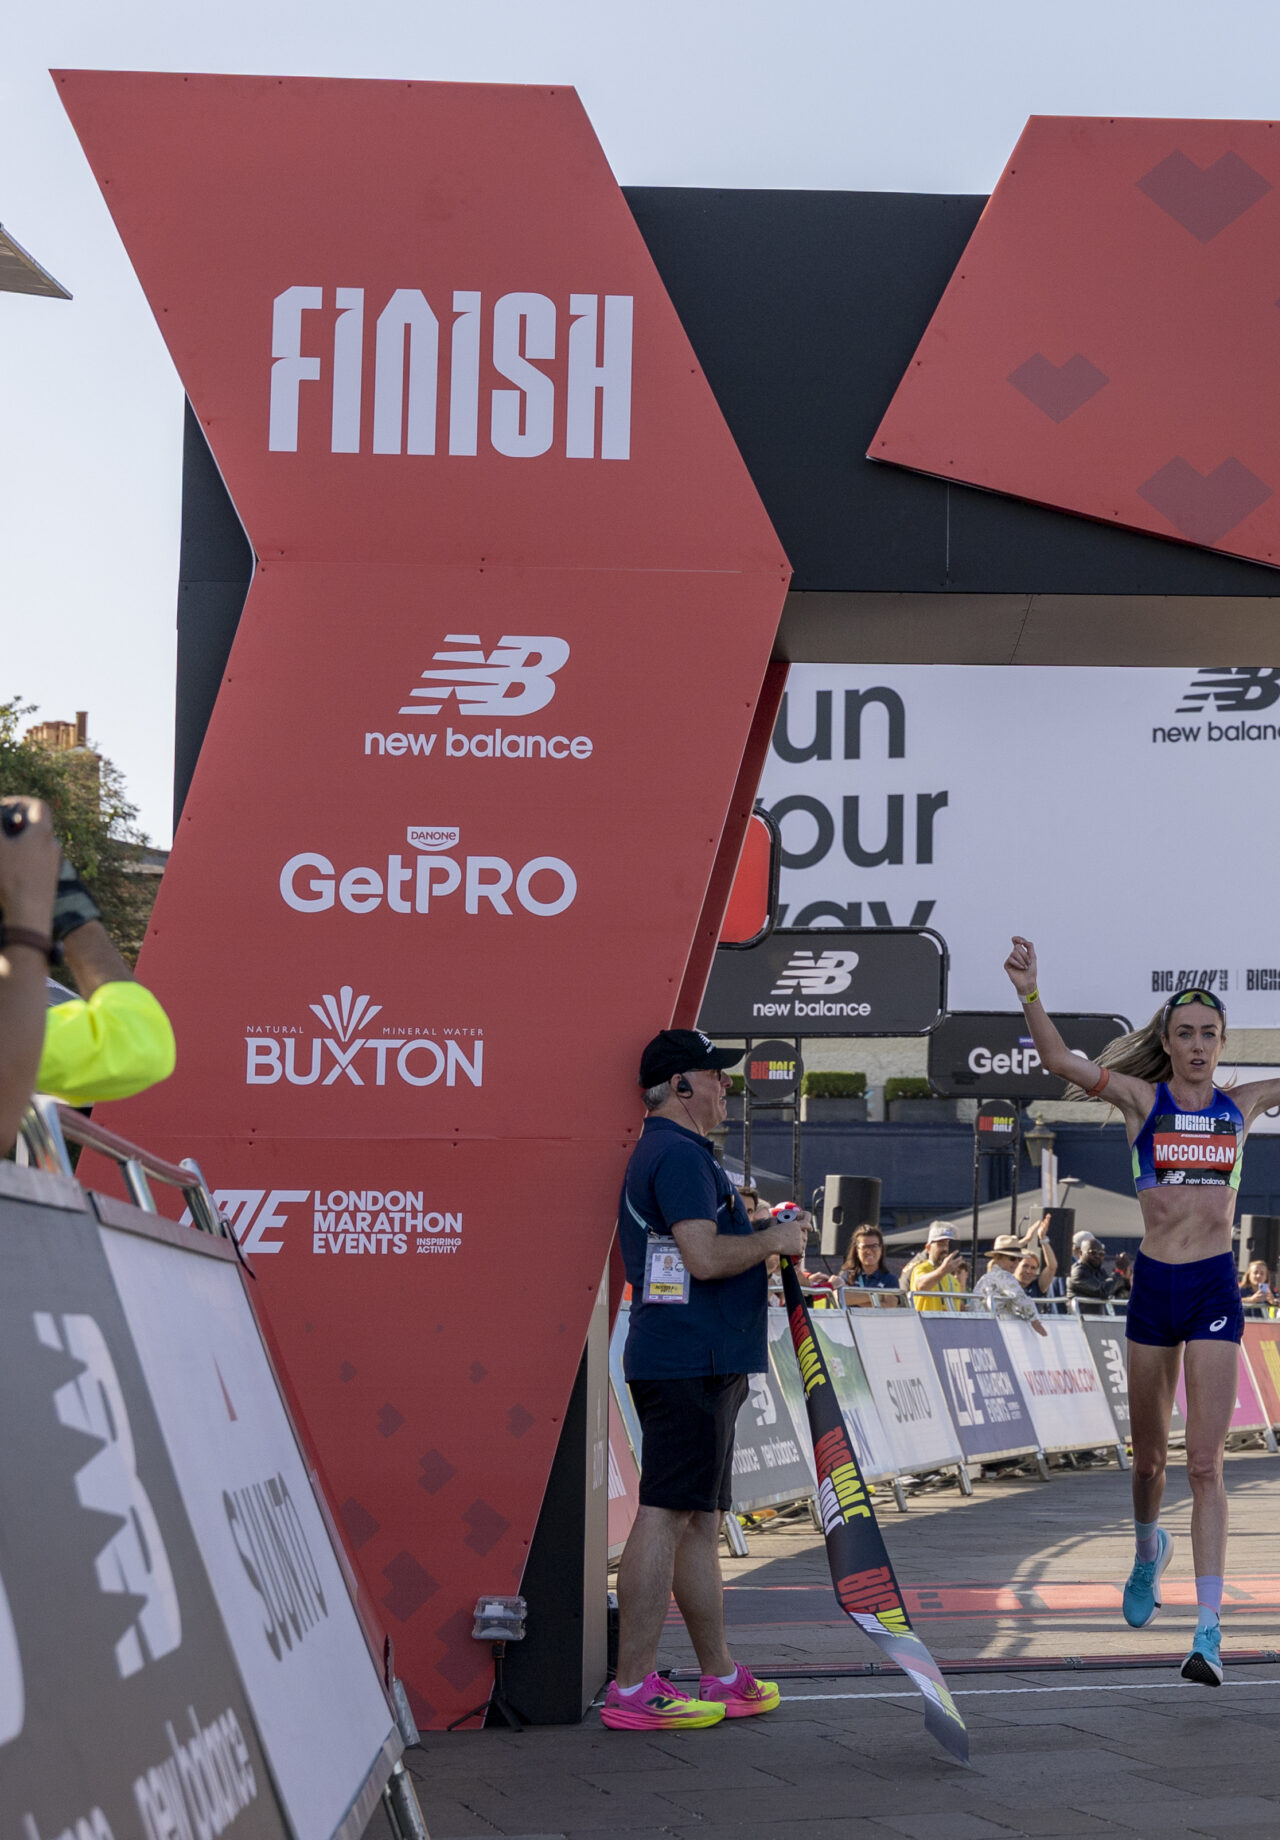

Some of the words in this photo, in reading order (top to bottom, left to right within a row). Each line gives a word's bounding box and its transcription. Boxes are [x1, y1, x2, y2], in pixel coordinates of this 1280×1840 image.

[268, 285, 634, 460] FINISH
[771, 686, 906, 763] un
[1152, 725, 1201, 743] new
[364, 731, 437, 757] new
[446, 728, 593, 759] balance
[411, 831, 457, 842] DANONE
[752, 790, 948, 870] our
[280, 852, 578, 917] GetPRO
[1152, 971, 1173, 992] BIG
[753, 1002, 791, 1017] new
[795, 1000, 872, 1017] balance
[246, 1025, 305, 1034] NATURAL
[383, 1027, 437, 1036] MINERAL
[443, 1028, 484, 1036] WATER
[244, 1037, 484, 1087] BUXTON
[968, 1047, 1089, 1076] GetP
[1156, 1144, 1235, 1164] MCCOLGAN
[314, 1190, 424, 1212] LONDON
[313, 1212, 462, 1233] MARATHON
[313, 1234, 408, 1254] EVENTS
[416, 1238, 462, 1246] INSPIRING
[416, 1246, 458, 1254] ACTIVITY
[886, 1378, 933, 1424] SUUNTO
[222, 1472, 328, 1663] SUUNTO
